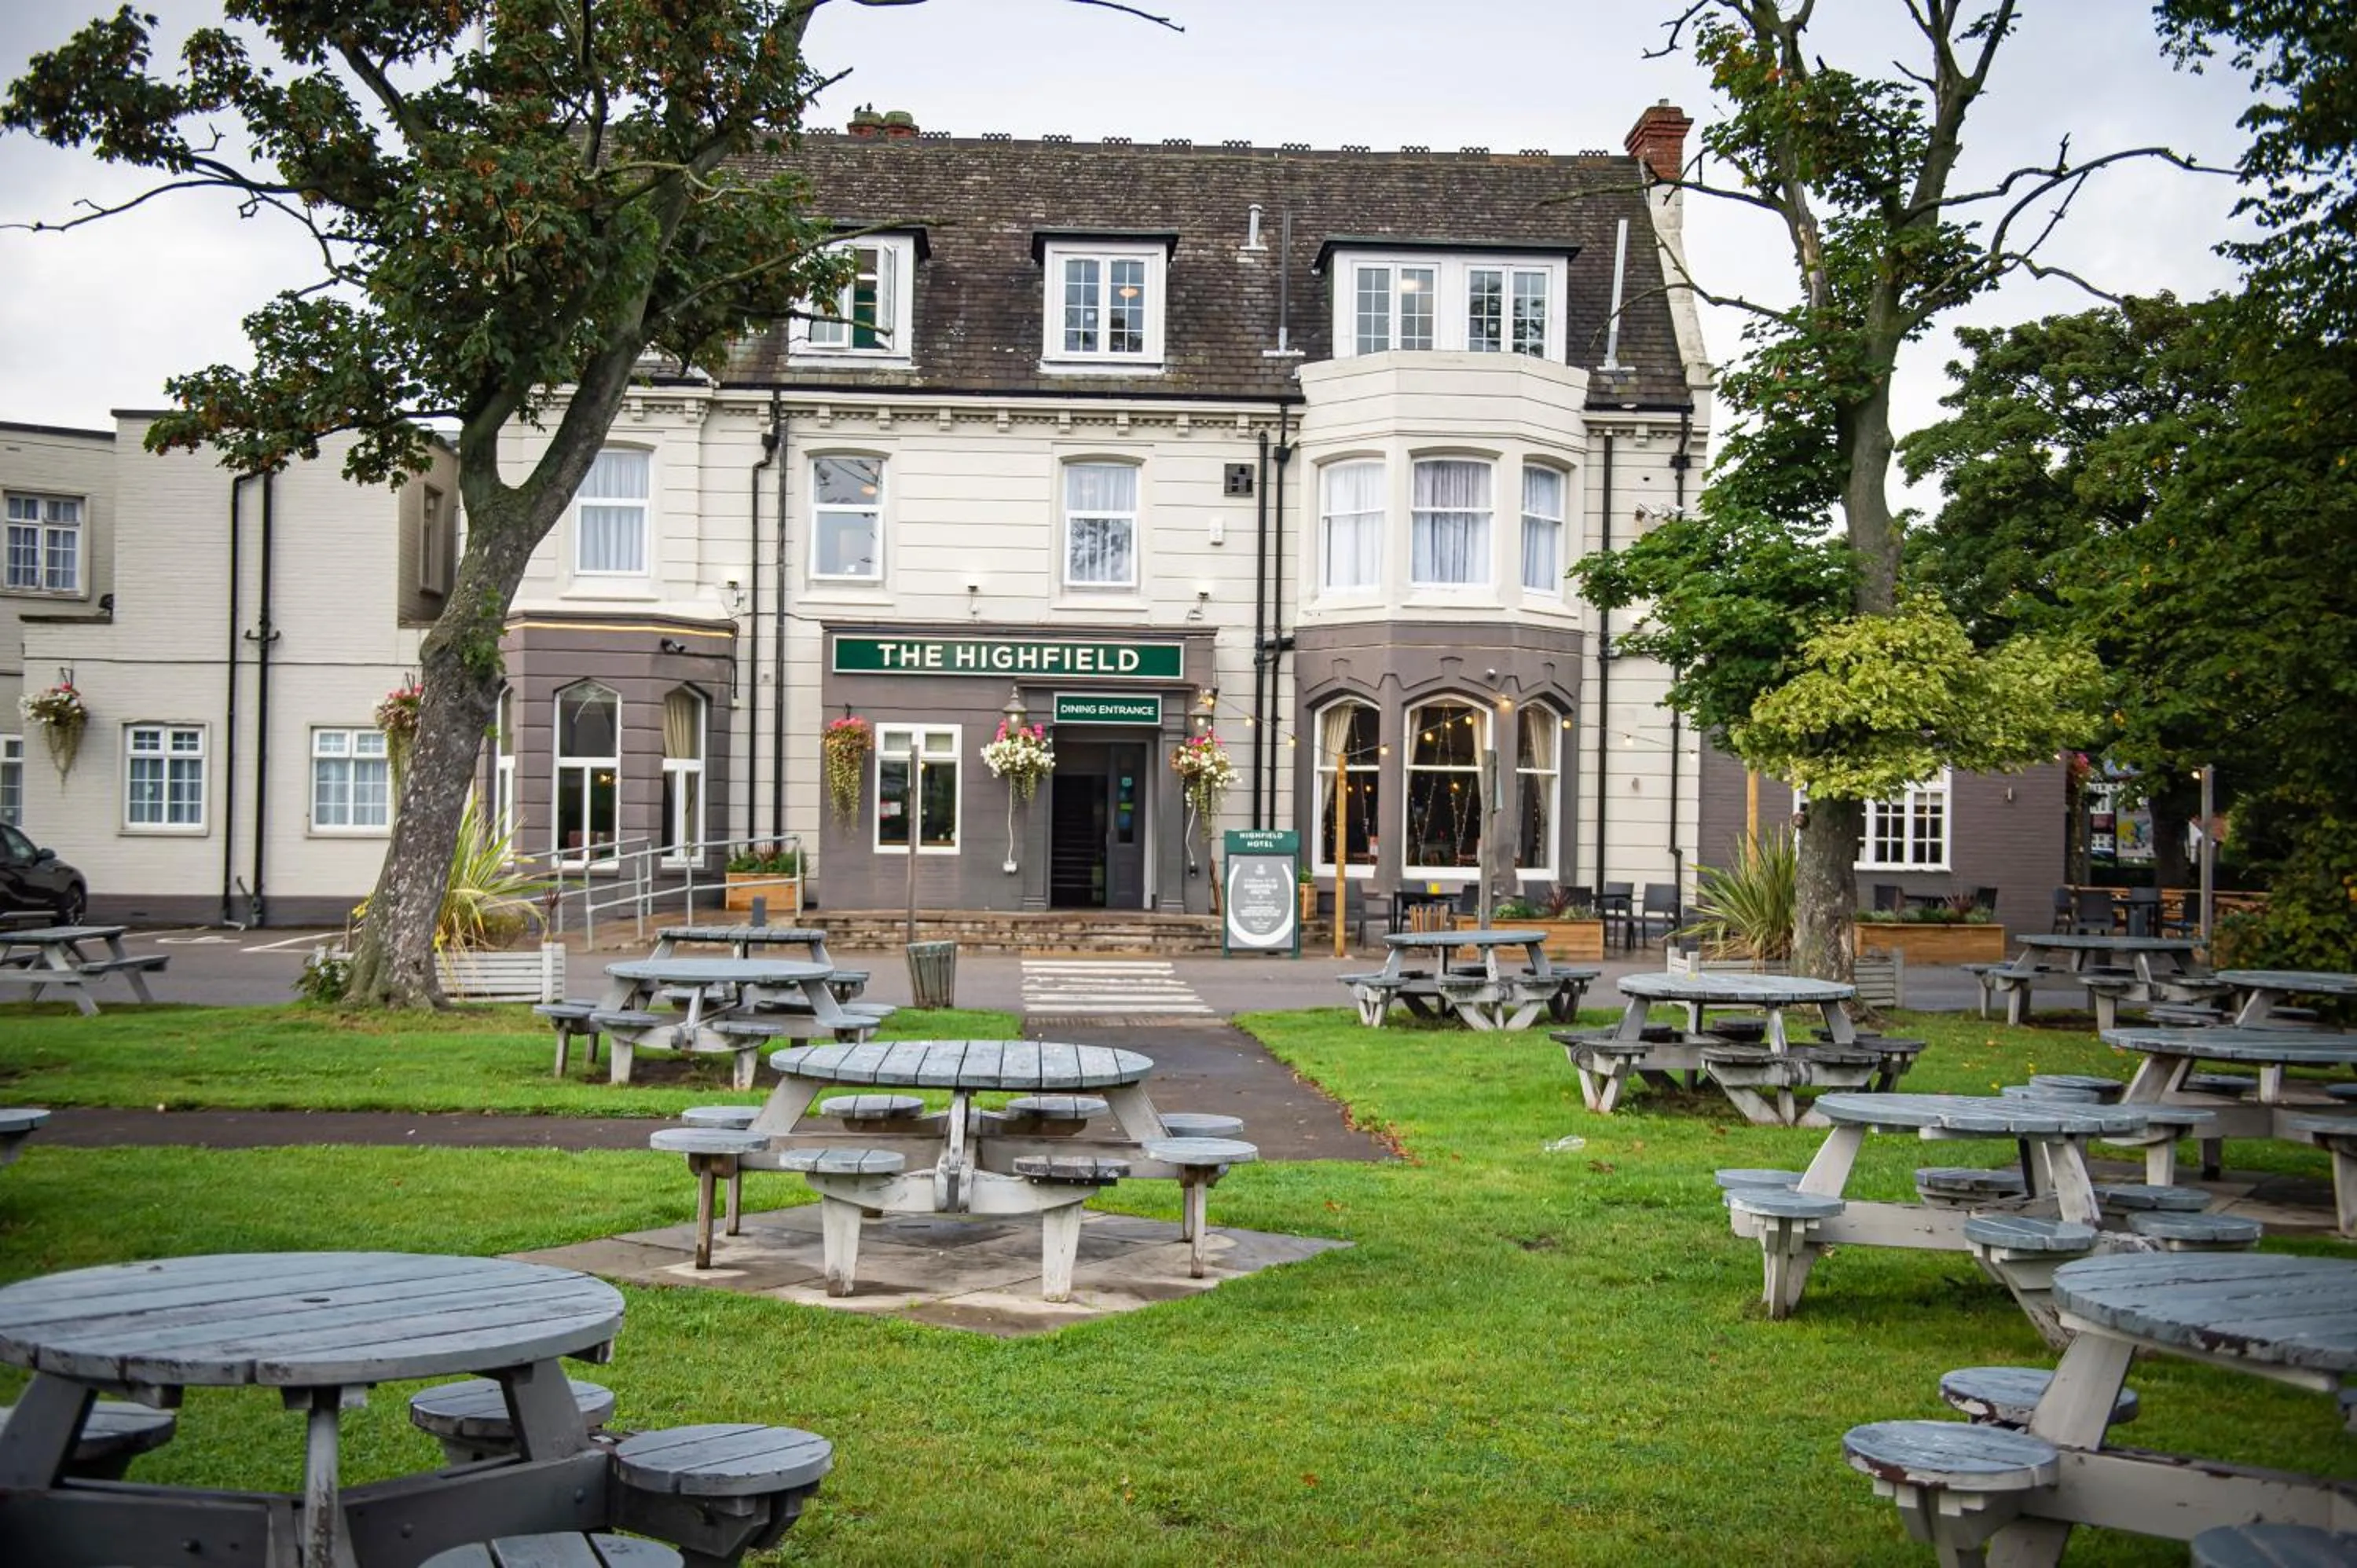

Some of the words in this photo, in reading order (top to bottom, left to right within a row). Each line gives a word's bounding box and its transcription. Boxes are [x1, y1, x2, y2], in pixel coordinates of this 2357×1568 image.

[877, 643, 943, 667] THE
[955, 645, 1140, 672] HIGHFIELD
[1060, 704, 1097, 714] DINING
[1098, 705, 1155, 716] ENTRANCE
